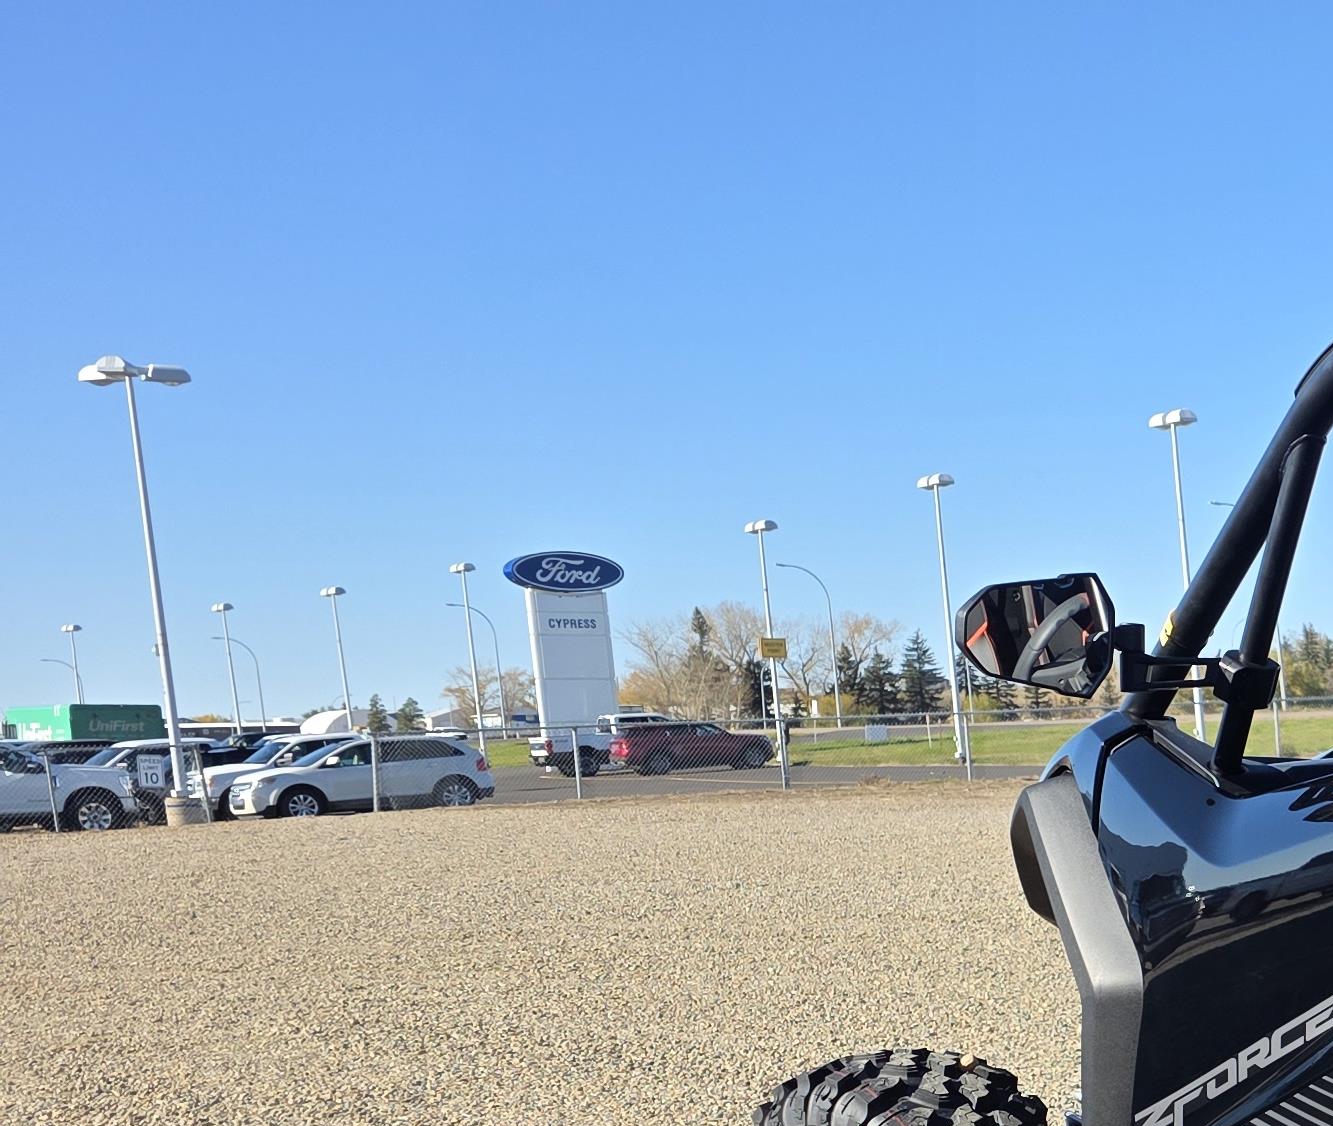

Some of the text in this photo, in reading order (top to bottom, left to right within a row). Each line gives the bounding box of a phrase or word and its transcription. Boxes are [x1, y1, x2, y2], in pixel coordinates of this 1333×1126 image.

[535, 557, 601, 584] Ford
[548, 618, 597, 629] CYPRESS
[88, 719, 145, 732] UniFirst
[144, 772, 159, 785] 10
